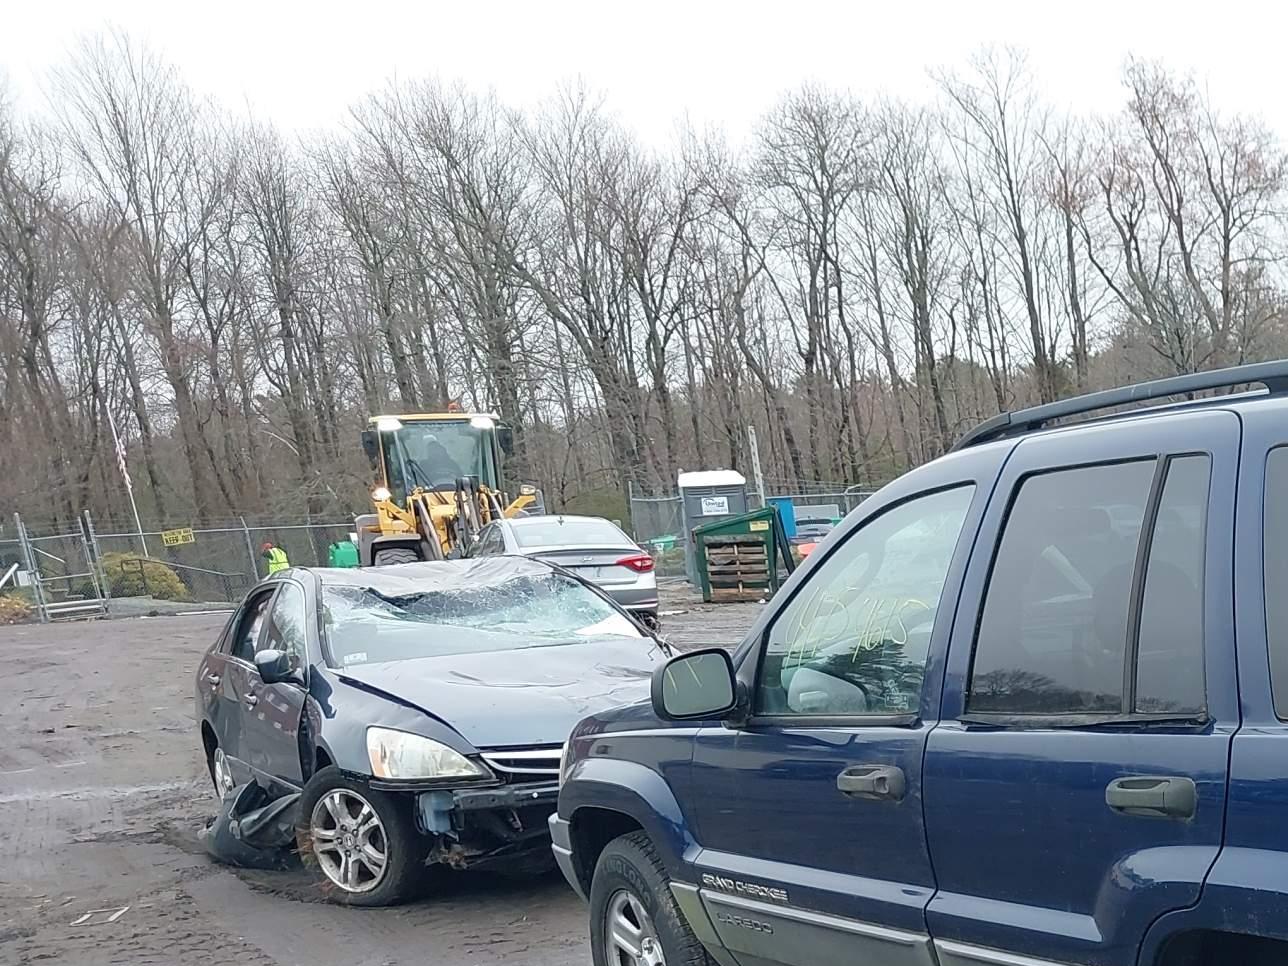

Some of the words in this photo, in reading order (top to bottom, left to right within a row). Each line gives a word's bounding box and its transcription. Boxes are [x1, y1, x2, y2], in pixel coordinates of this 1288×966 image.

[702, 873, 734, 890] GRAND
[735, 880, 789, 901] CHEROKEE
[716, 911, 774, 935] LAREDO
